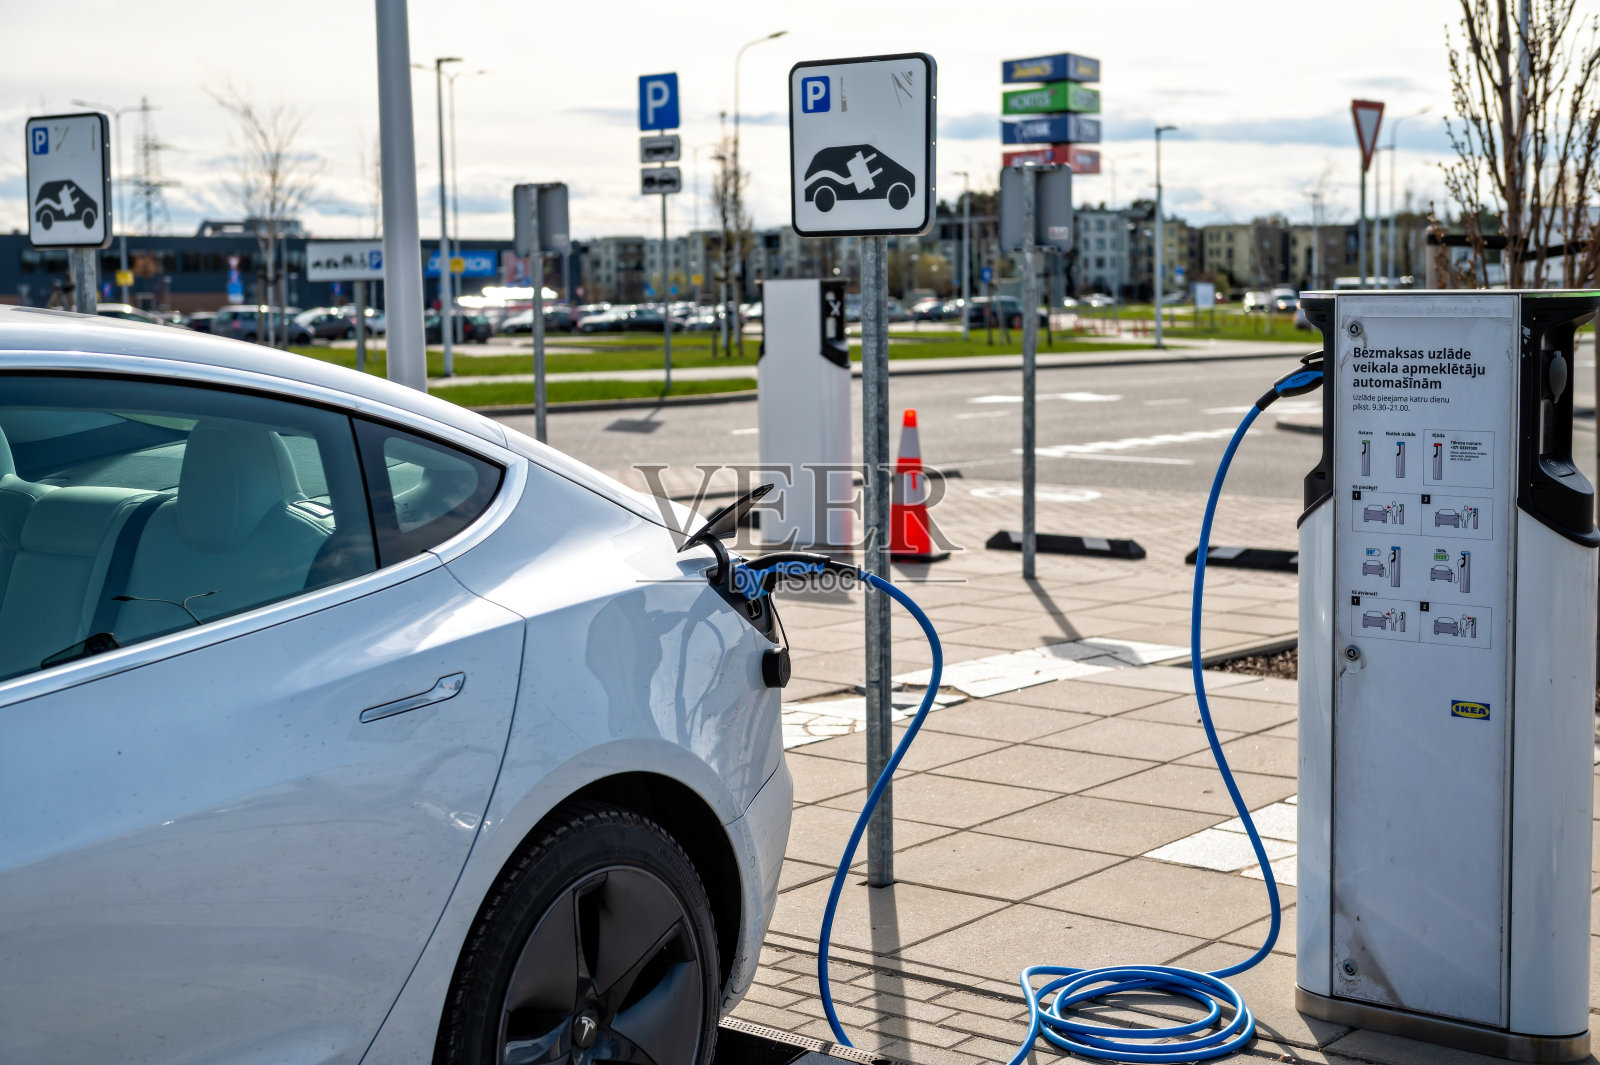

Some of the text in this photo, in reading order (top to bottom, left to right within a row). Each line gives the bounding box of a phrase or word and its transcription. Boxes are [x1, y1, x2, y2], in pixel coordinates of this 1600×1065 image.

[646, 80, 670, 124] P
[806, 80, 827, 111] P
[35, 130, 46, 153] P
[1353, 347, 1471, 360] Bezmaksas uzlāde
[1353, 362, 1485, 378] veikala apmeklētāju
[1353, 376, 1442, 389] automašīnām
[1353, 394, 1449, 404] Uzlāde pieejama katru dienu
[1353, 403, 1371, 412] plkst.
[1455, 705, 1487, 715] IKEA
